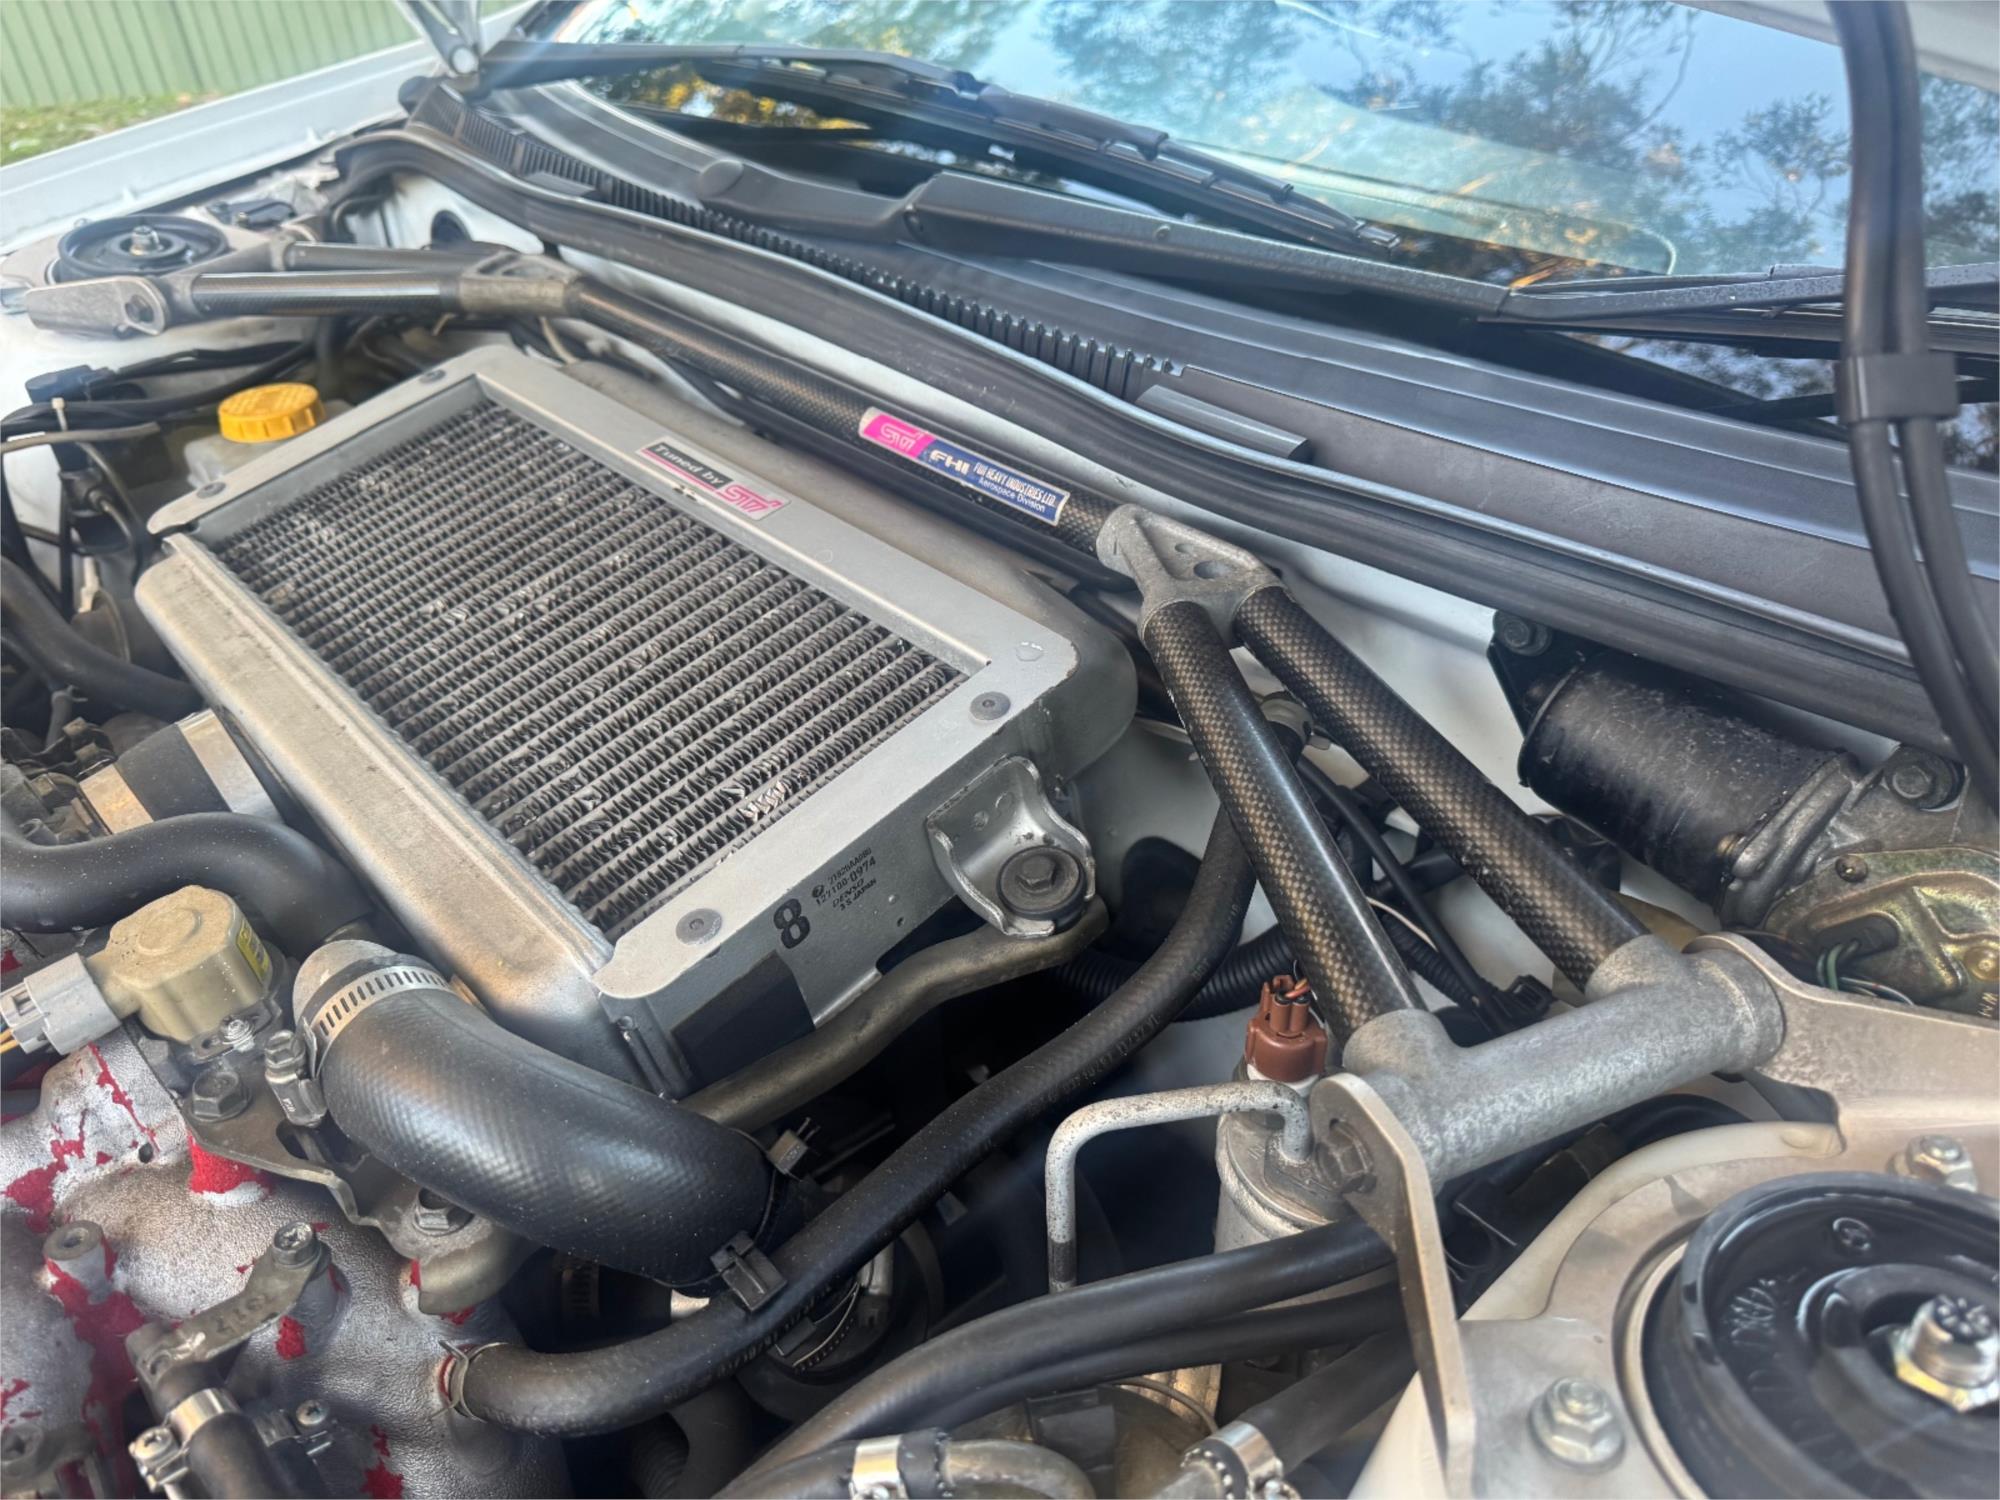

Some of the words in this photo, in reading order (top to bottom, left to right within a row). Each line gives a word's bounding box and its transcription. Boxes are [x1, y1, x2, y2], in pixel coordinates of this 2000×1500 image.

[655, 445, 703, 473] Tuned
[702, 471, 724, 484] by
[930, 449, 970, 475] FHI
[979, 477, 1016, 500] Aerospace
[1017, 493, 1045, 513] Division
[987, 466, 1007, 485] HEAVY
[1006, 474, 1044, 501] INDUSTRIES
[833, 878, 864, 908] DENSO
[853, 878, 877, 901] JAPAN
[774, 898, 810, 949] 8
